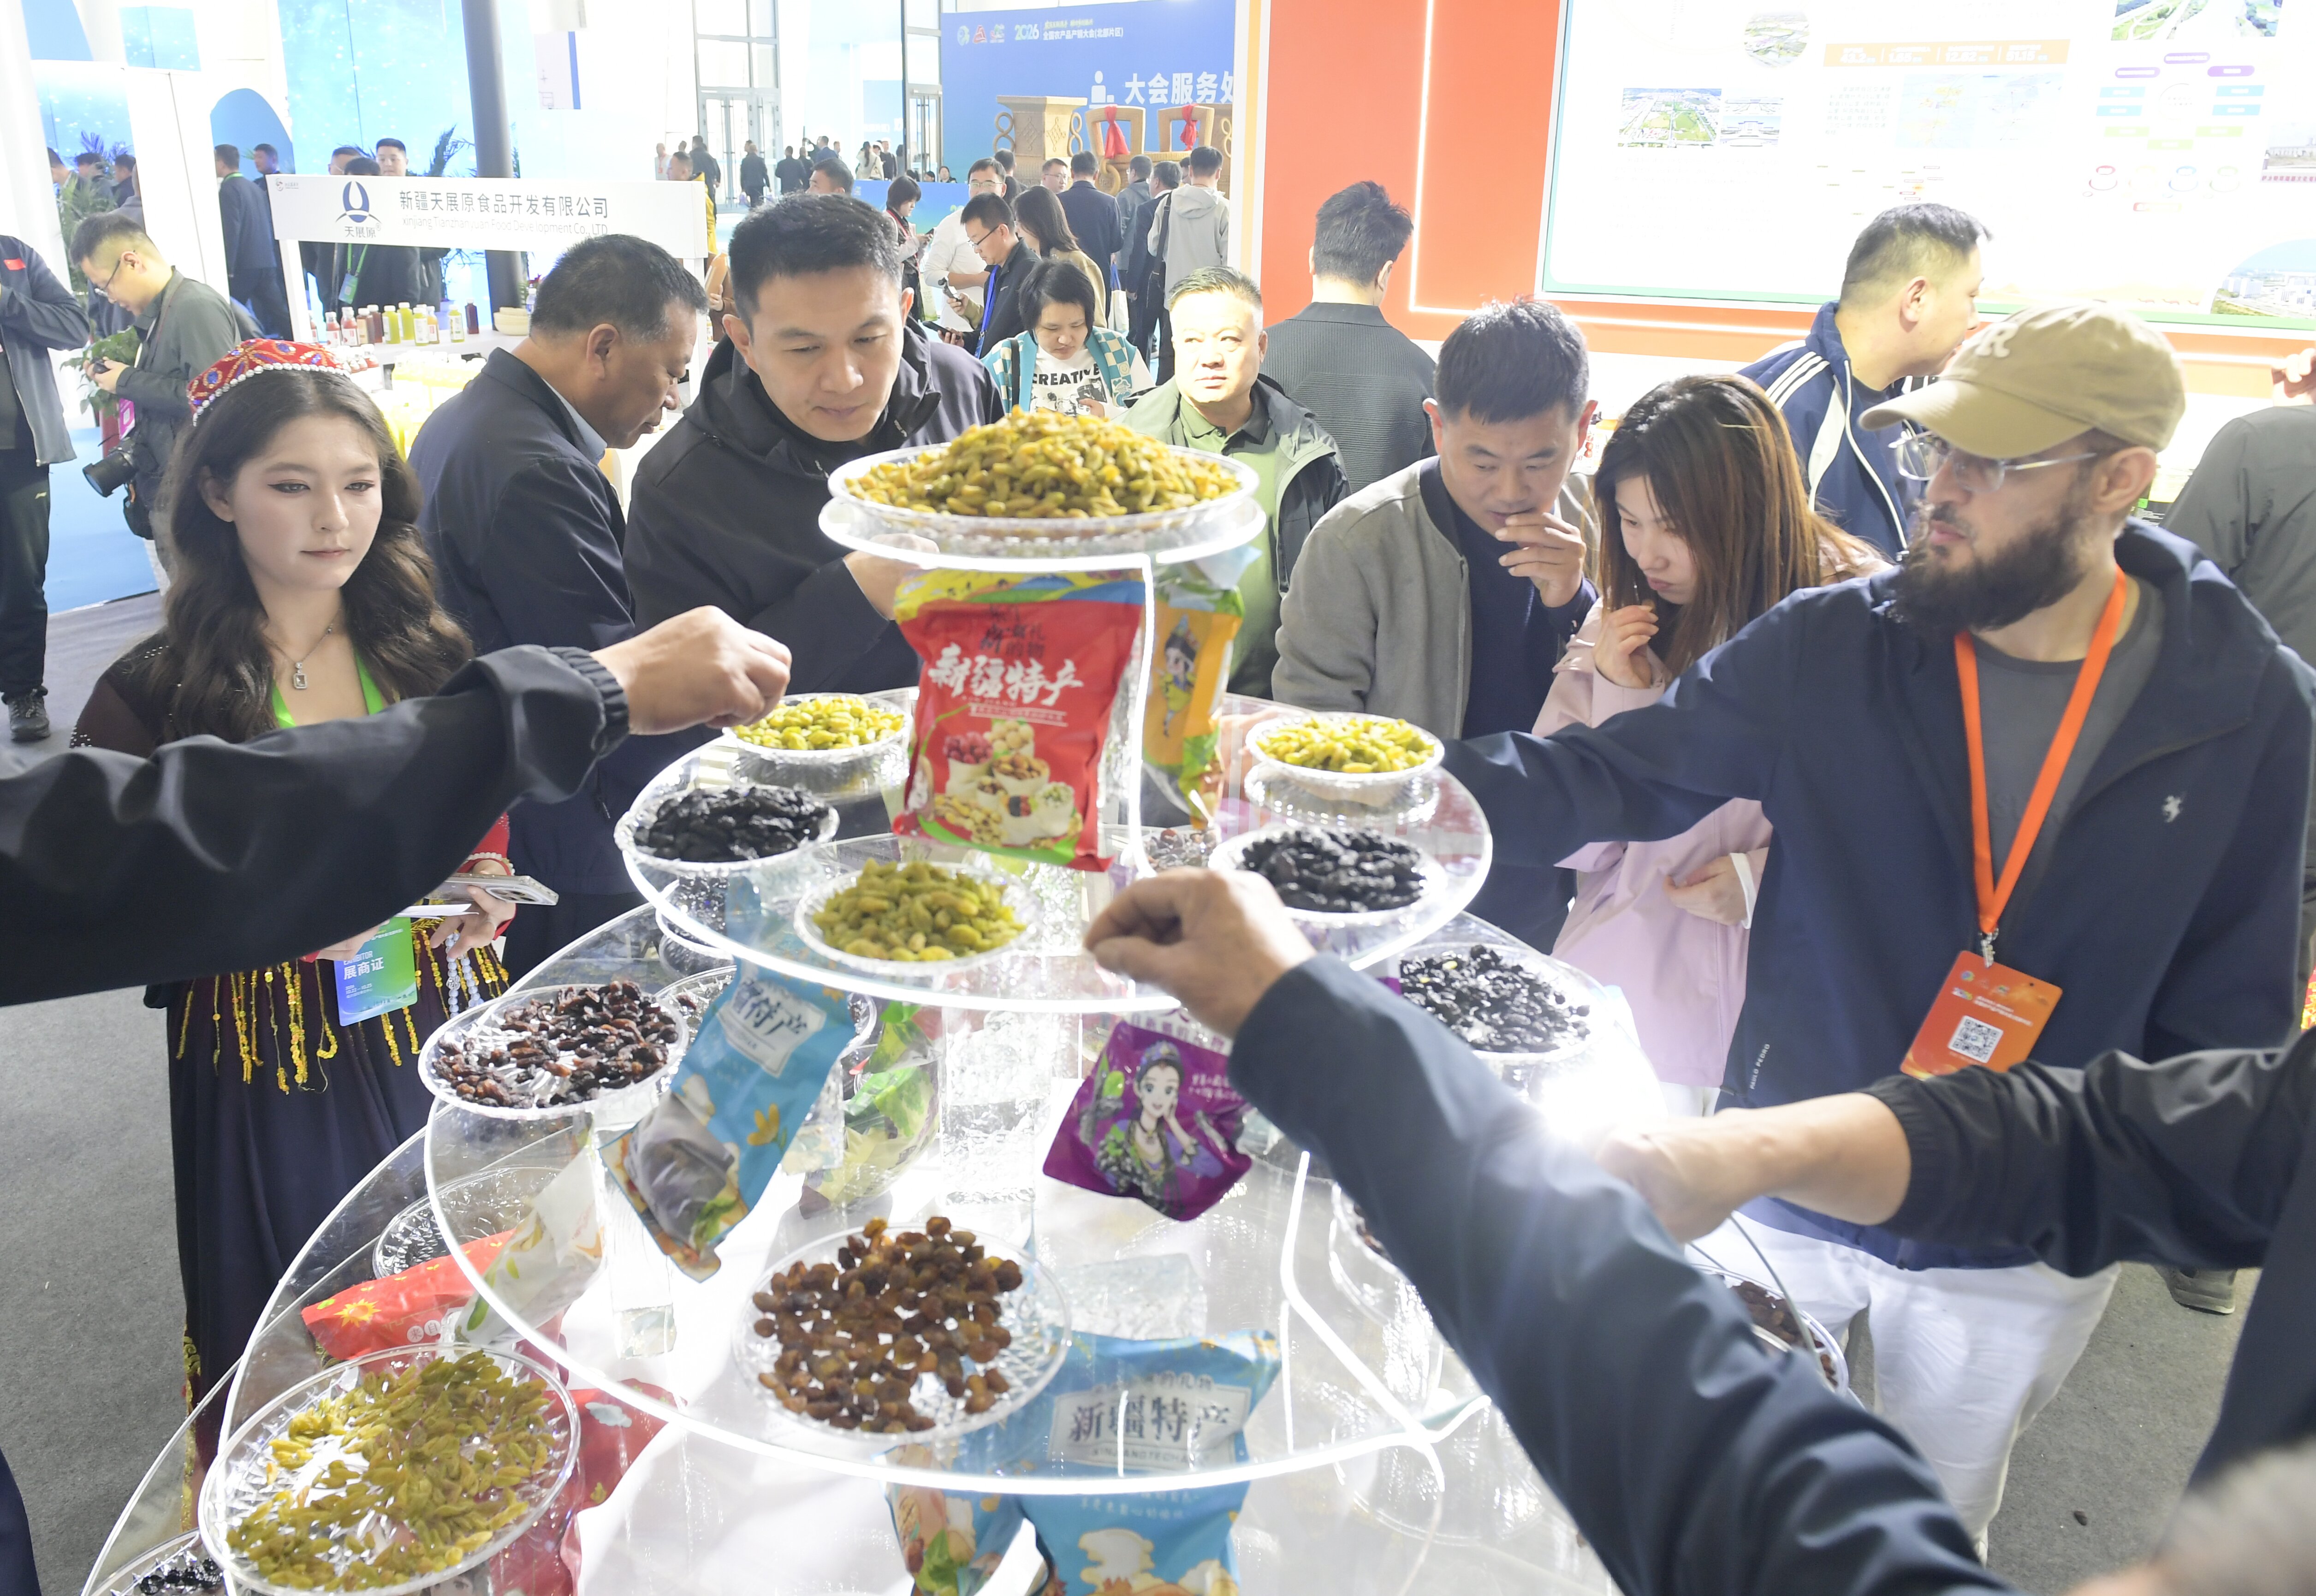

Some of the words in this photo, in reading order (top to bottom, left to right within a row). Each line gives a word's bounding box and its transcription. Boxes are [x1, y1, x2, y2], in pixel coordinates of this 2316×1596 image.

[1015, 24, 1039, 41] 2026
[399, 190, 608, 219] 新疆天展原食品开发有限公司
[344, 226, 377, 238] 天展原
[491, 219, 511, 231] Food
[927, 641, 1084, 707] 新疆特产
[344, 957, 384, 980] 展商证
